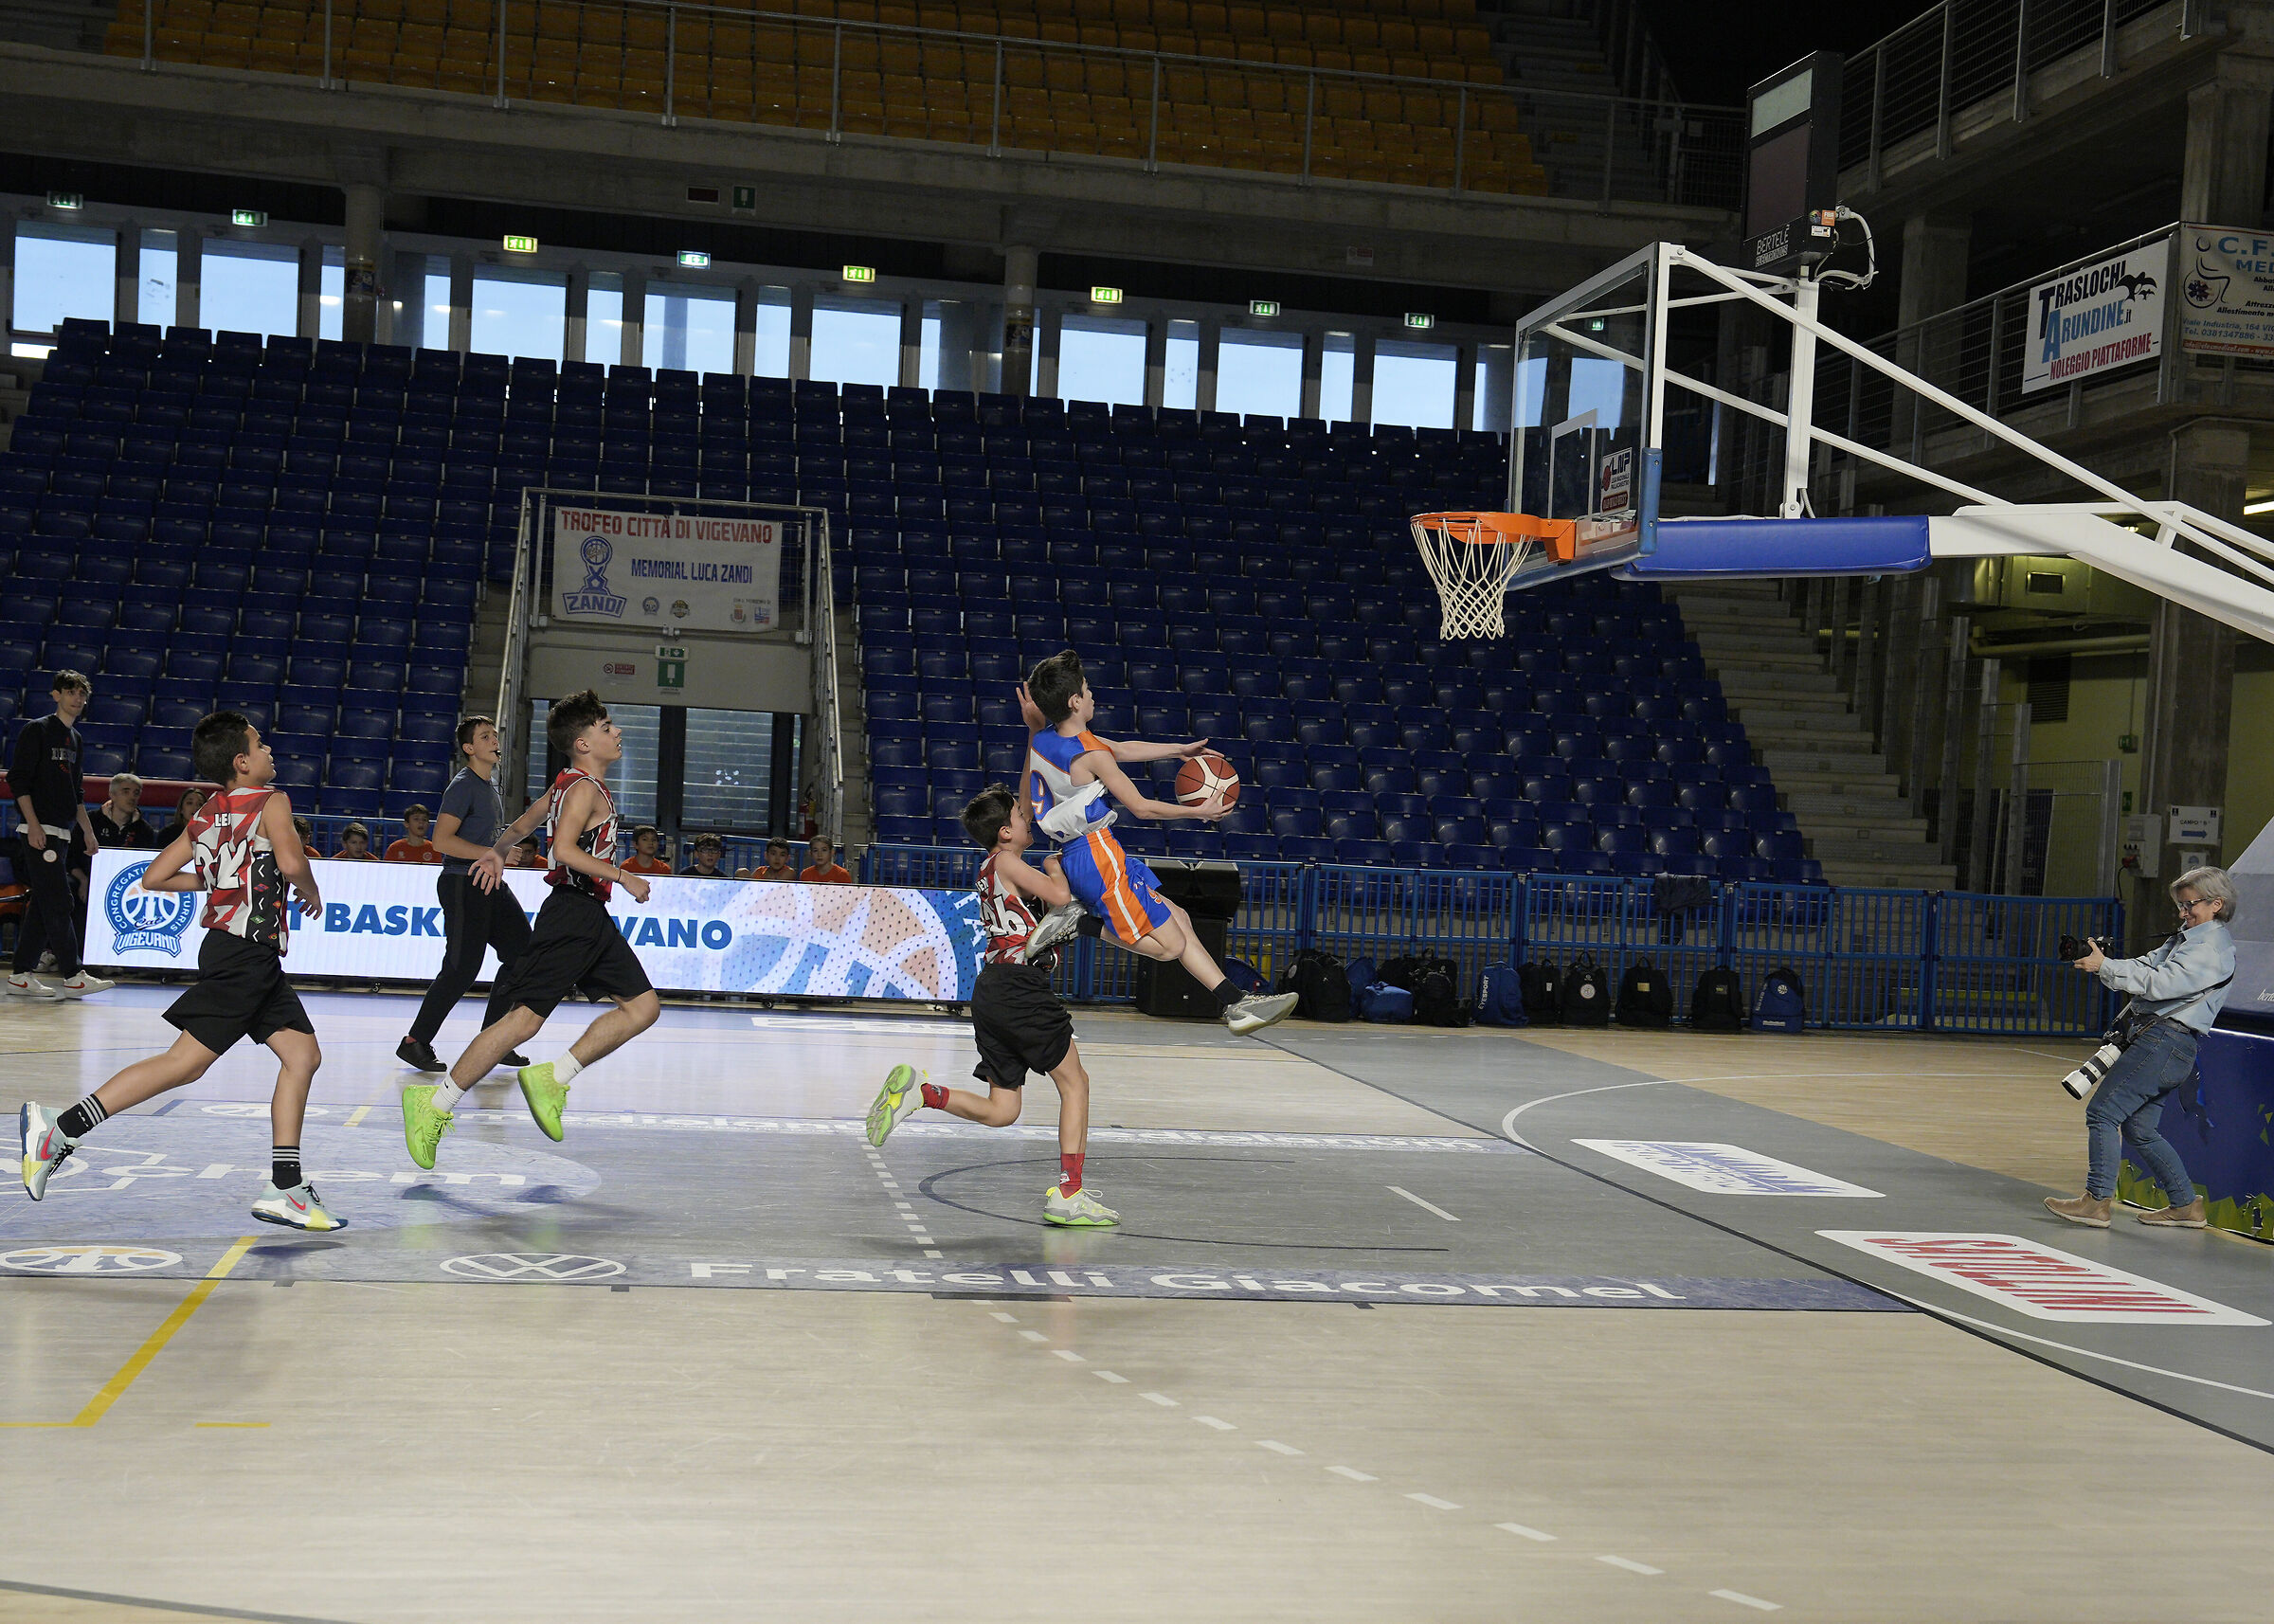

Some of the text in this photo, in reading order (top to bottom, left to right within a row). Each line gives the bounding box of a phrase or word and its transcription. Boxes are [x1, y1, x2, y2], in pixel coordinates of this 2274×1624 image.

[2039, 260, 2126, 340] TRASLOCHI
[2217, 307, 2265, 317] Allestimento
[2183, 317, 2200, 326] Viale
[2184, 327, 2199, 335] Tel.
[2049, 333, 2152, 380] NOLEGGIO PIATTAFORME
[561, 511, 772, 544] TROFEO CITTÀ DI VIGEVANO
[631, 558, 752, 584] MEMORIAL LUCA ZANDI
[567, 595, 623, 615] ZANDI
[170, 893, 191, 932] TURRIS
[117, 930, 178, 953] VIGEVANO
[1477, 975, 1490, 1010] EYESPORT
[690, 1262, 1687, 1300] Fratelli Giacomel
